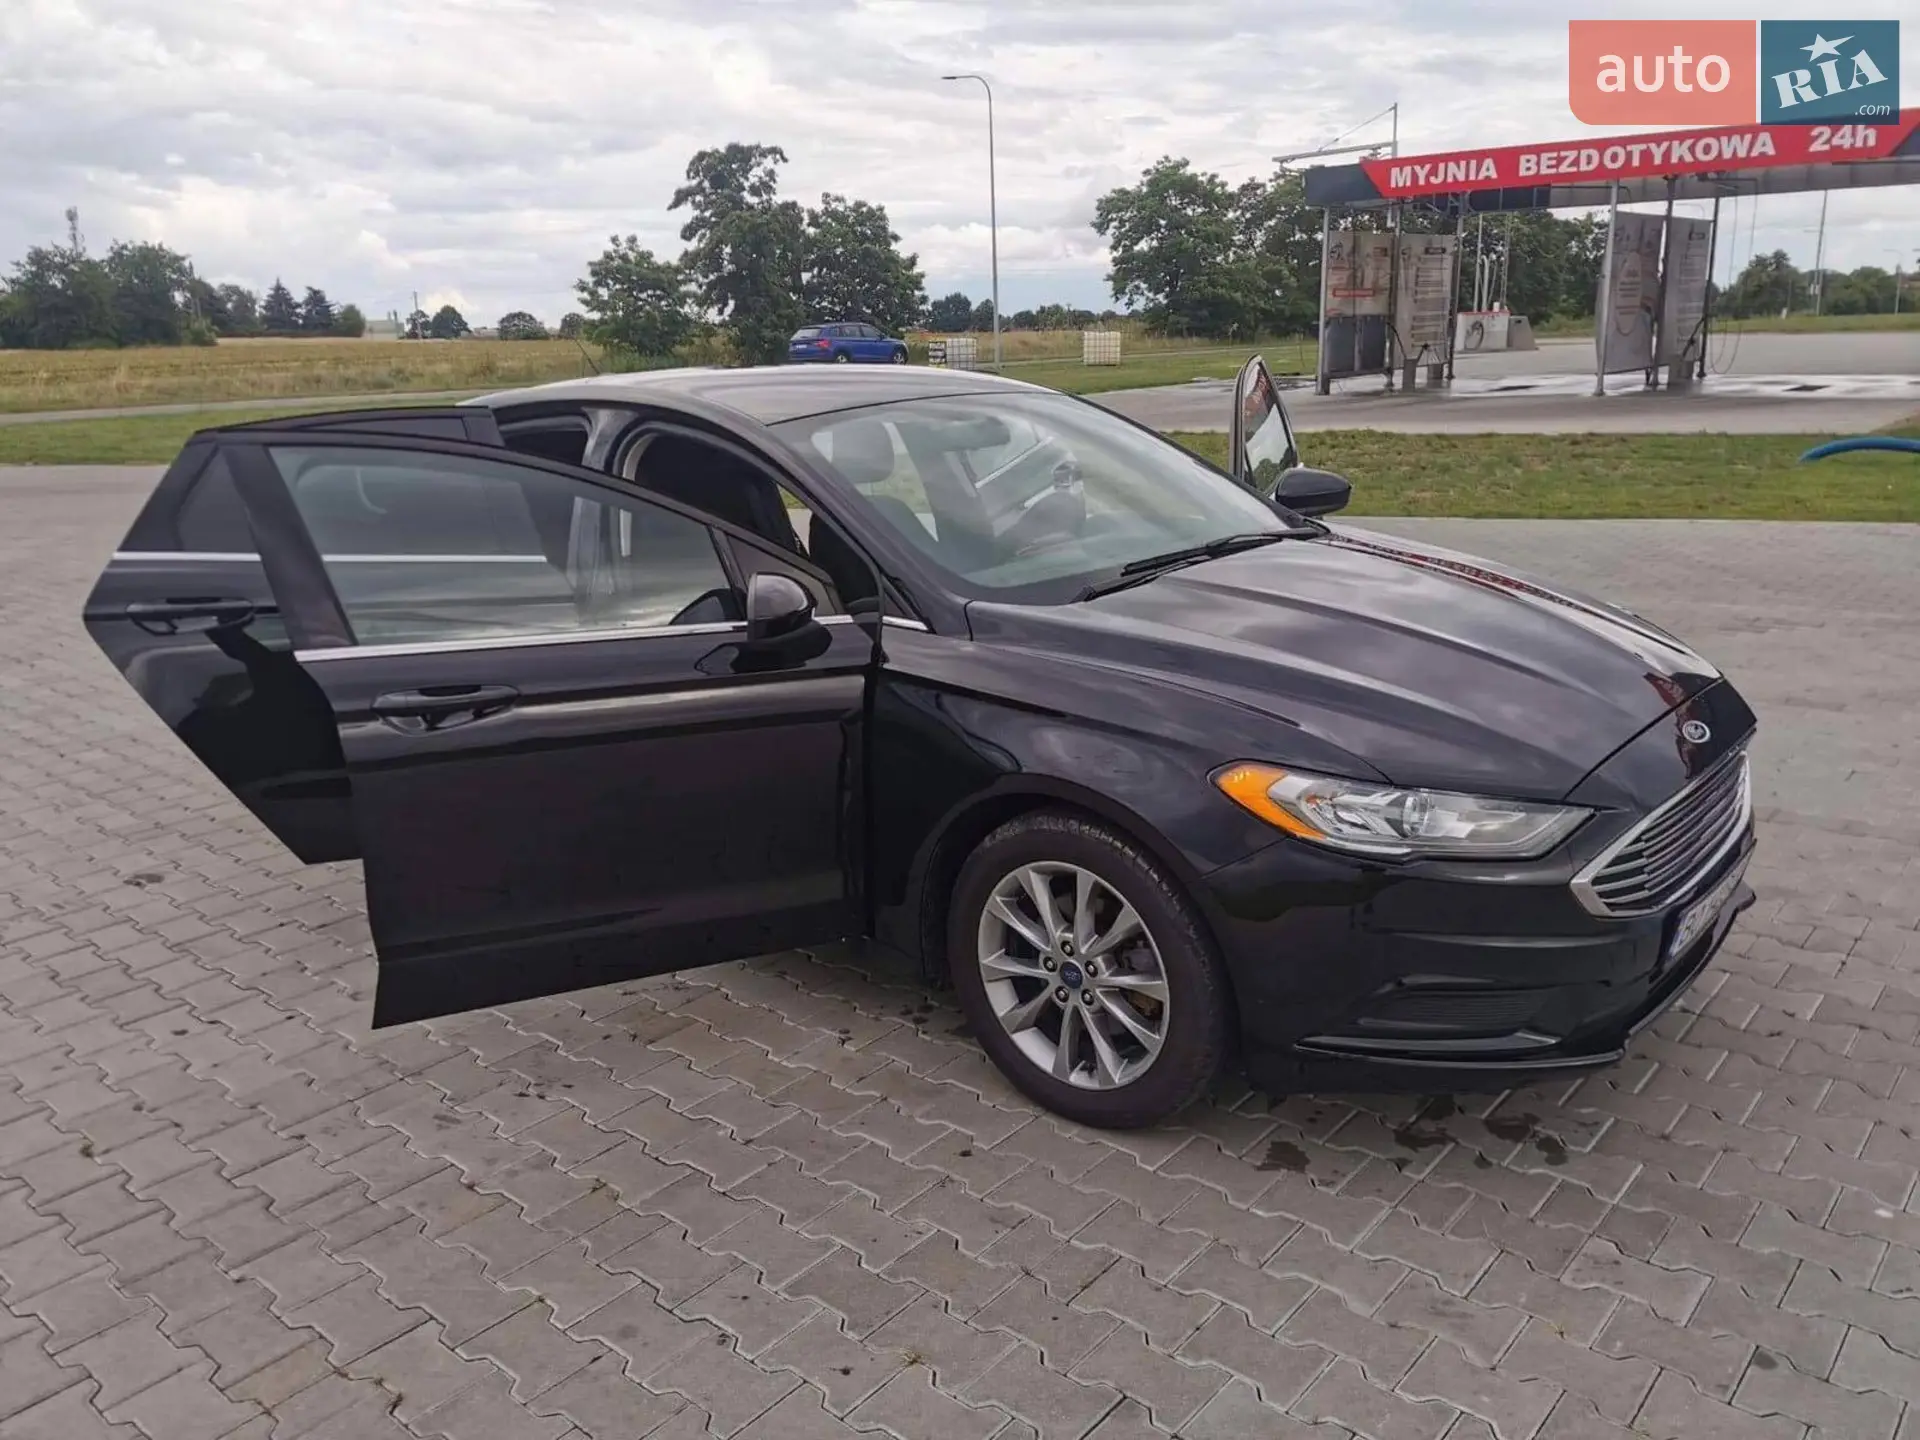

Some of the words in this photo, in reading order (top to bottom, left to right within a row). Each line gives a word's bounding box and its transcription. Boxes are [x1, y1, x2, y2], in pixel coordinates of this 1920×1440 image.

[1390, 157, 1498, 188] MYJNIA
[1518, 131, 1776, 177] BEZDOTYKOWA
[1808, 125, 1877, 152] 24h
